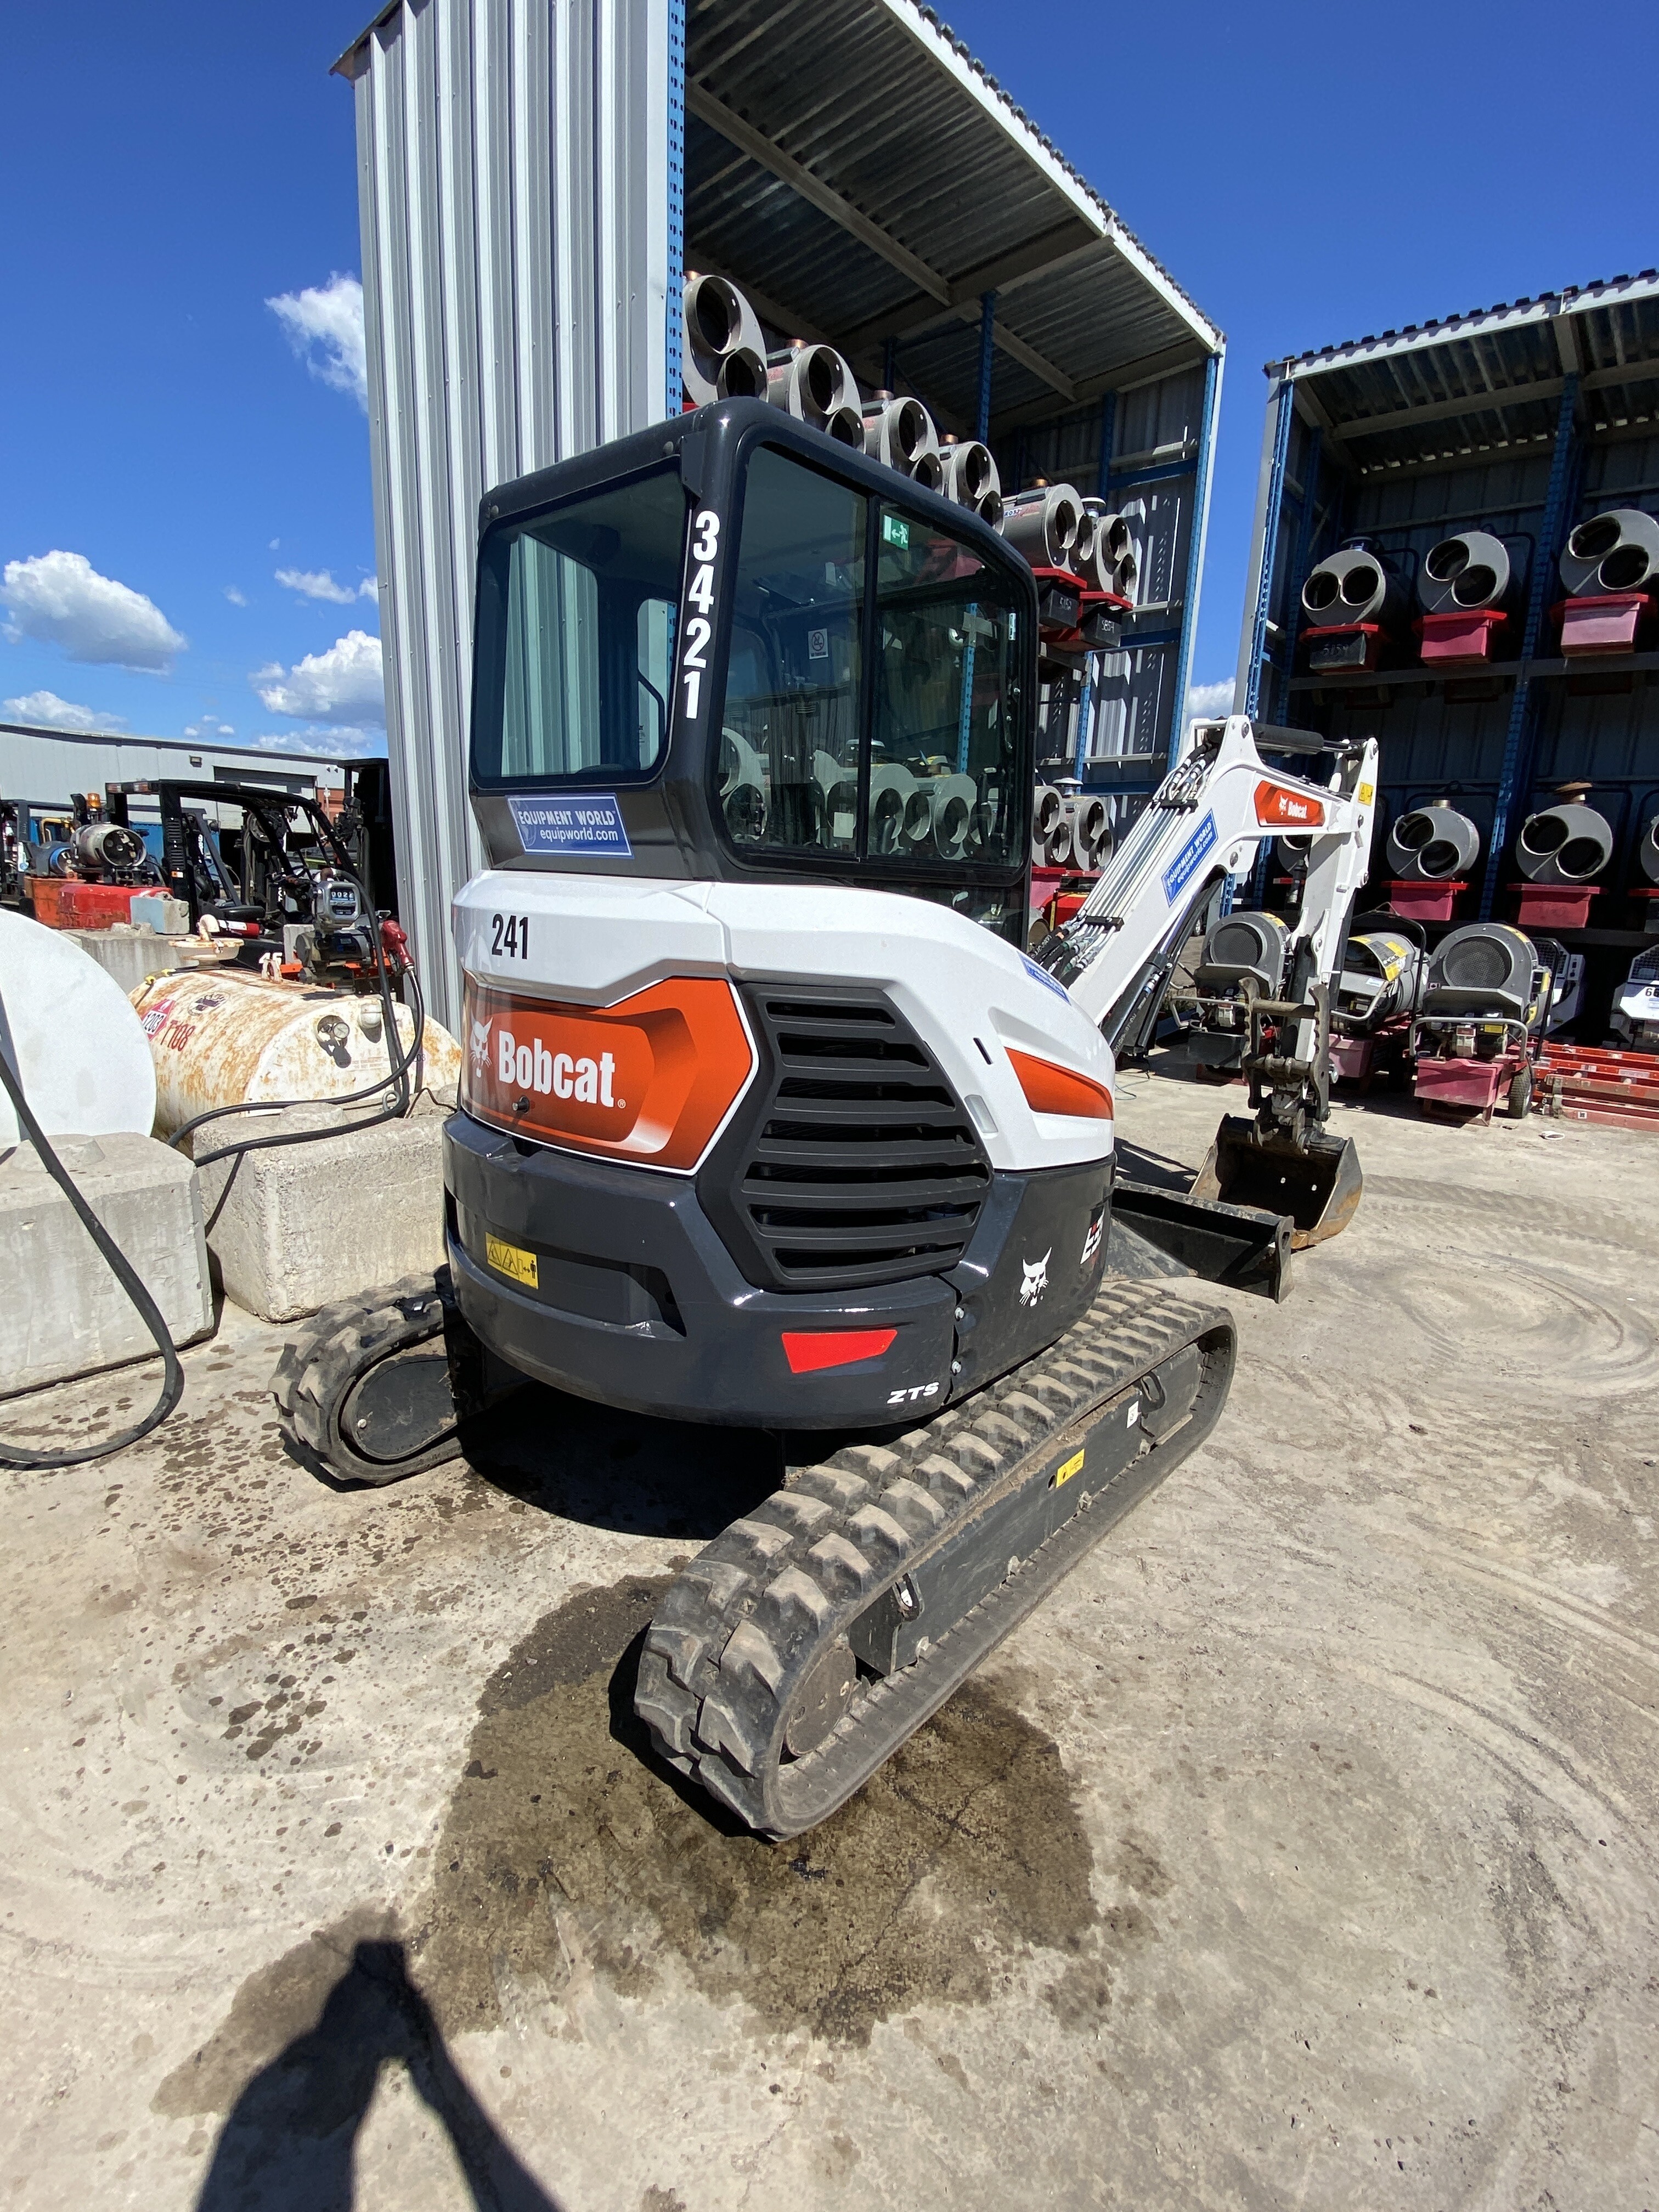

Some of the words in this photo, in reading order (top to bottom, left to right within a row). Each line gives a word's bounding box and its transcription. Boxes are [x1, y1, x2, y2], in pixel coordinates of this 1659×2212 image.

[683, 510, 720, 719] 3421
[517, 810, 573, 825] EQUIPMENT
[574, 810, 616, 826] WORLD
[1287, 800, 1308, 819] Bobcat
[540, 826, 619, 843] equipworld.com
[1167, 845, 1194, 887] EQUIPMENT
[1194, 821, 1212, 848] WORLD
[1177, 831, 1214, 883] equipworld.com
[492, 913, 528, 960] 241
[143, 1012, 165, 1033] 1203
[499, 1030, 616, 1108] Bobcat
[887, 1382, 940, 1404] ZTS
